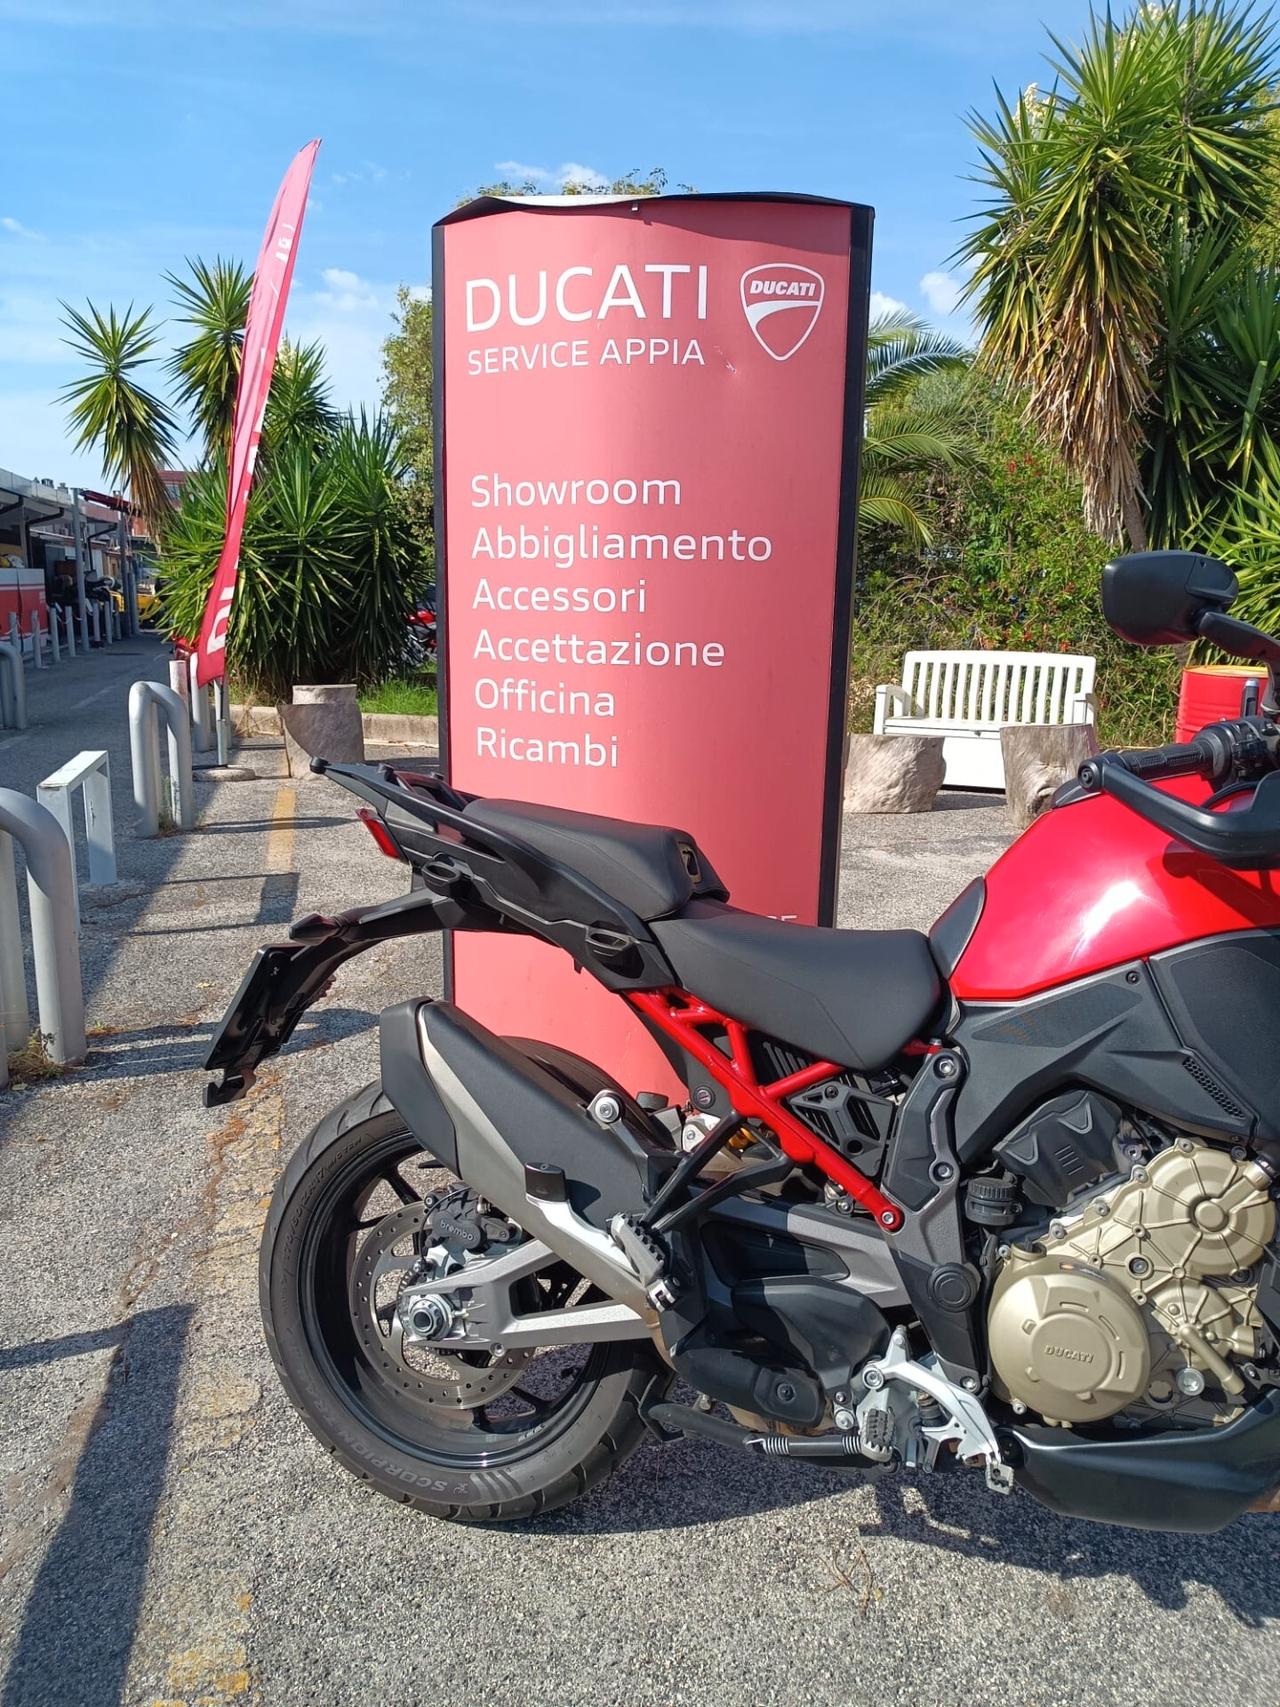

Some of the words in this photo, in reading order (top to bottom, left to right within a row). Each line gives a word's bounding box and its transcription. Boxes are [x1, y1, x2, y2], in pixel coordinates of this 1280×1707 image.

[466, 264, 708, 333] DUCATI
[749, 279, 817, 298] DUCATI
[468, 340, 589, 376] SERVICE
[599, 338, 705, 366] APPIA
[471, 473, 681, 508] Showroom
[471, 523, 773, 569] Abbigliamento
[472, 578, 646, 613] Accessori
[473, 628, 725, 667] Accettazione
[475, 678, 615, 717] Officina
[476, 726, 618, 768] Ricambi
[439, 1218, 474, 1241] brembo
[1043, 1343, 1095, 1364] DUCATI
[336, 1429, 449, 1492] SCORPION
